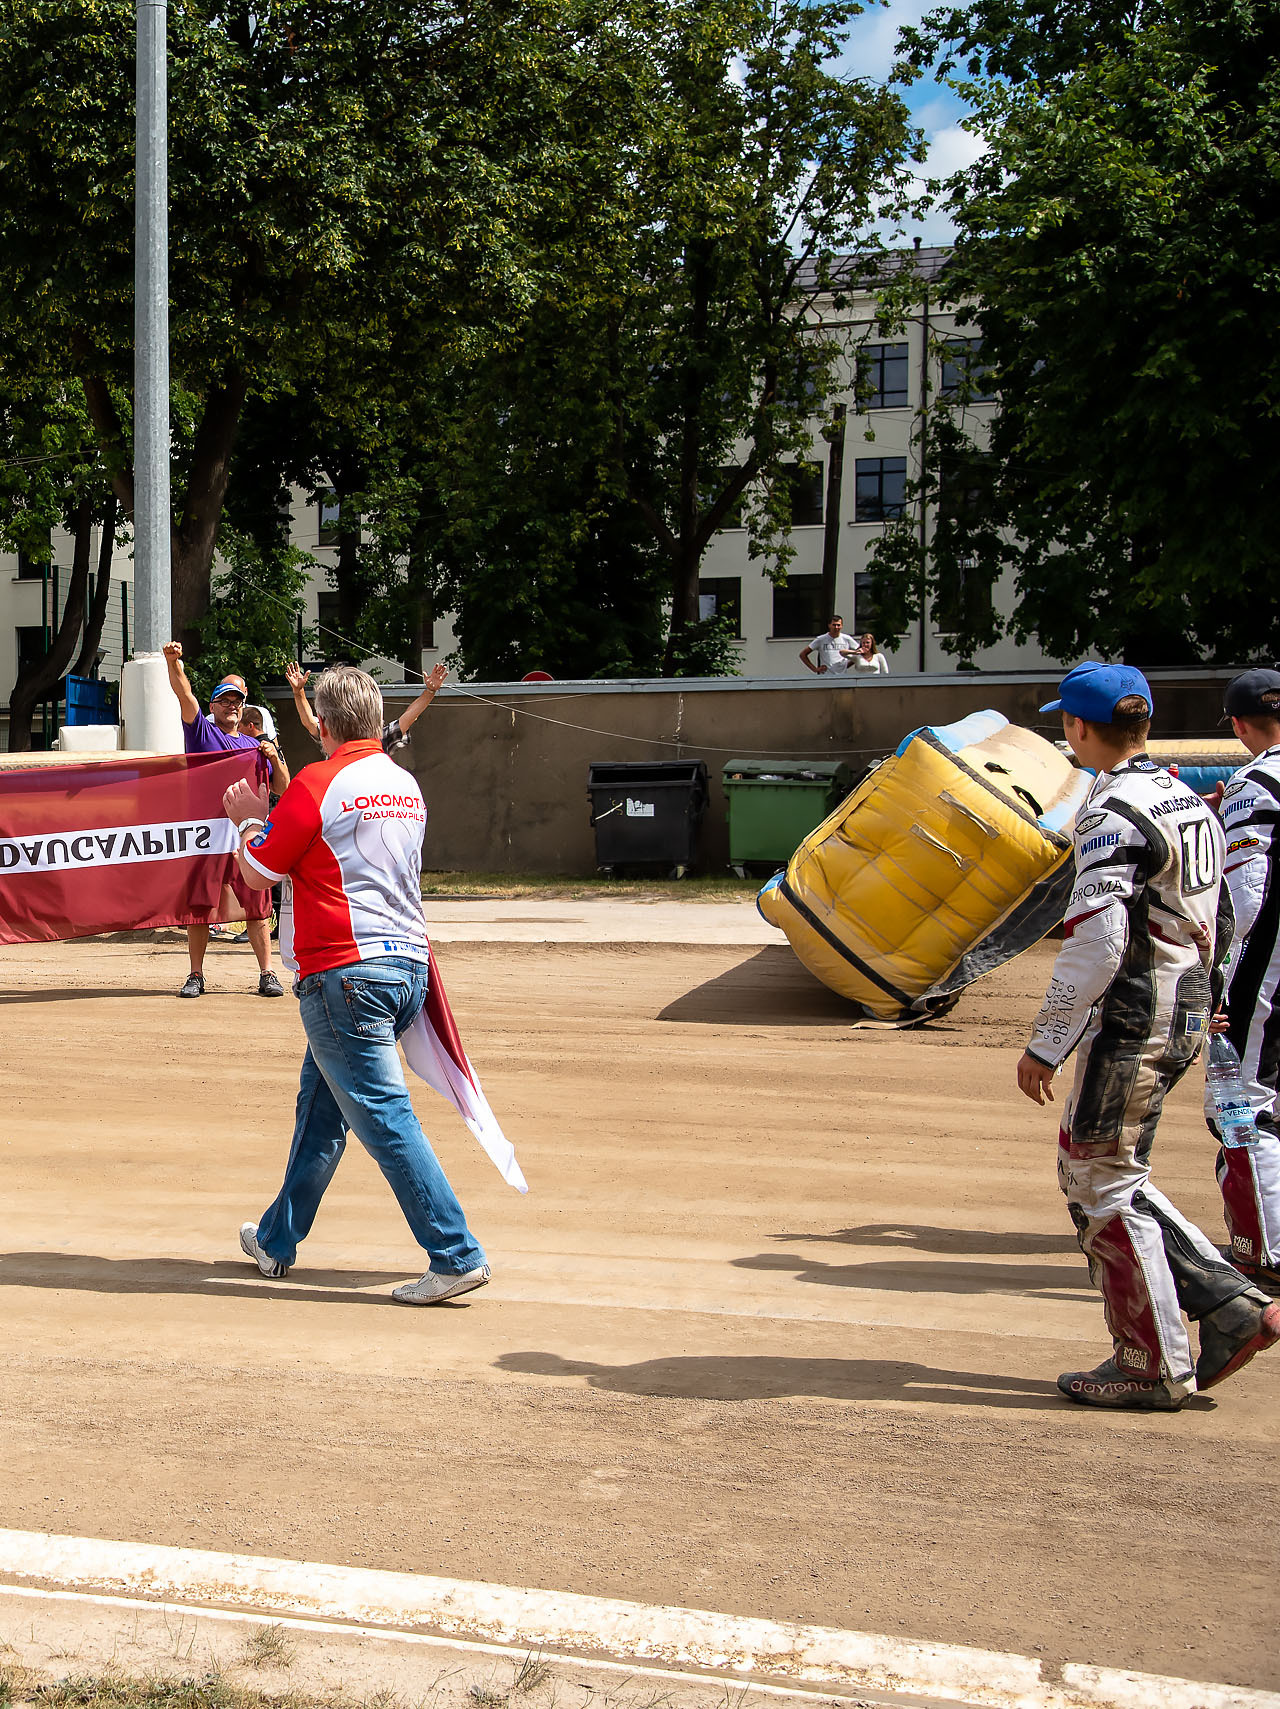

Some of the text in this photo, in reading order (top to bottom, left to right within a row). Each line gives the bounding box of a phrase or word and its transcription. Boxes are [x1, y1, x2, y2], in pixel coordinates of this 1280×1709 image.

[341, 794, 427, 812] LOKOMOT
[363, 810, 424, 822] DAUGAVPILS
[1182, 820, 1215, 888] 10
[1053, 994, 1078, 1036] BEAR
[1070, 1380, 1153, 1394] daytona
